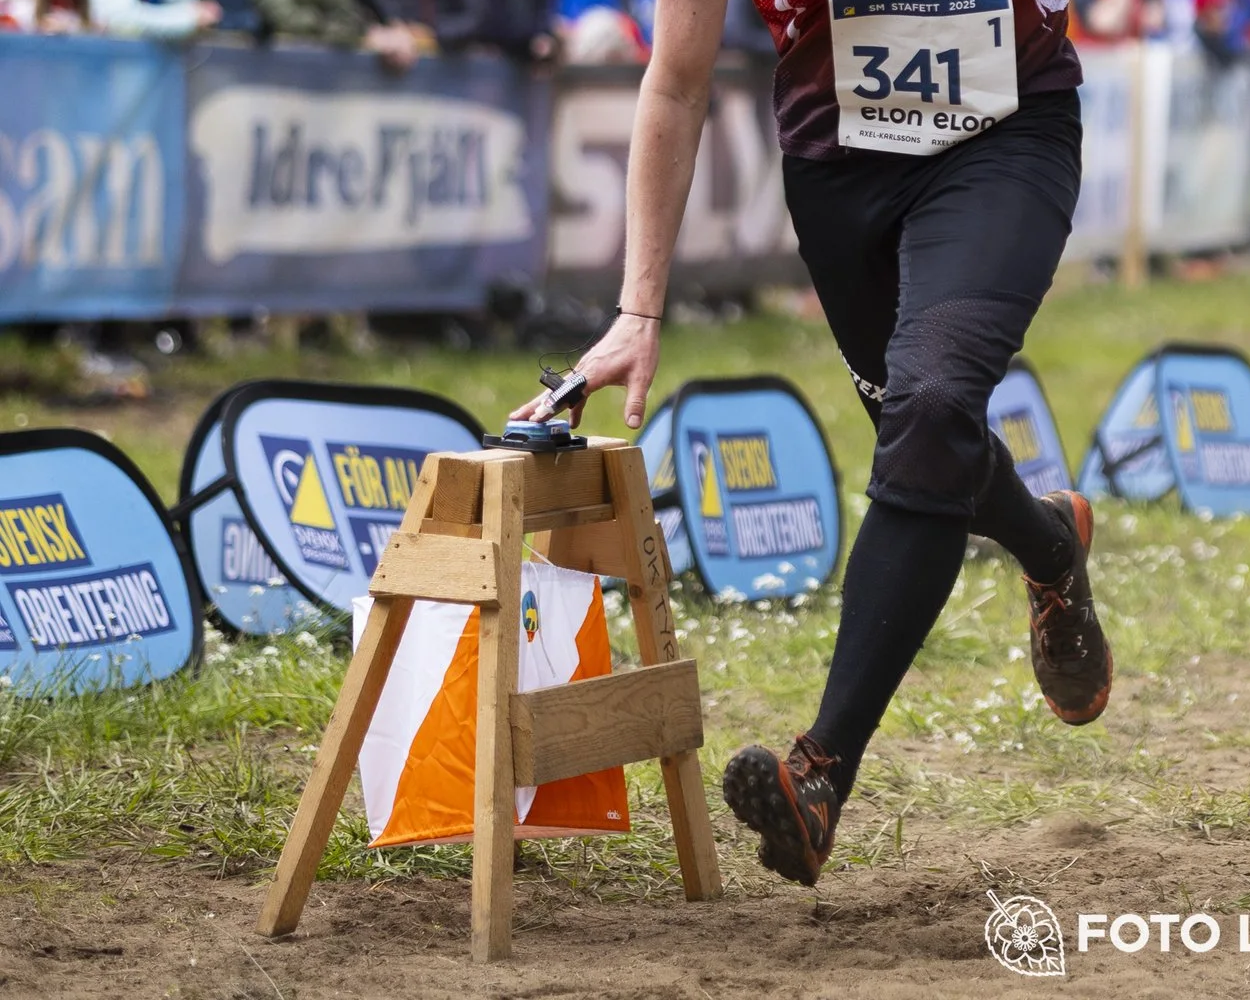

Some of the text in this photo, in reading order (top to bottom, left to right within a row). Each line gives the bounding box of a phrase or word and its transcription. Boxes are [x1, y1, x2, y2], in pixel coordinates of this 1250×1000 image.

[868, 0, 976, 12] SM STAFETT 2025
[987, 16, 1002, 48] 1
[852, 45, 962, 106] 341
[859, 130, 921, 144] AXEL-KARLSSONS
[333, 446, 388, 509] FÖR
[718, 437, 777, 489] SVENSK
[733, 499, 823, 557] ORIENTERING
[643, 536, 660, 585] OK
[15, 570, 170, 646] ORIENTERING
